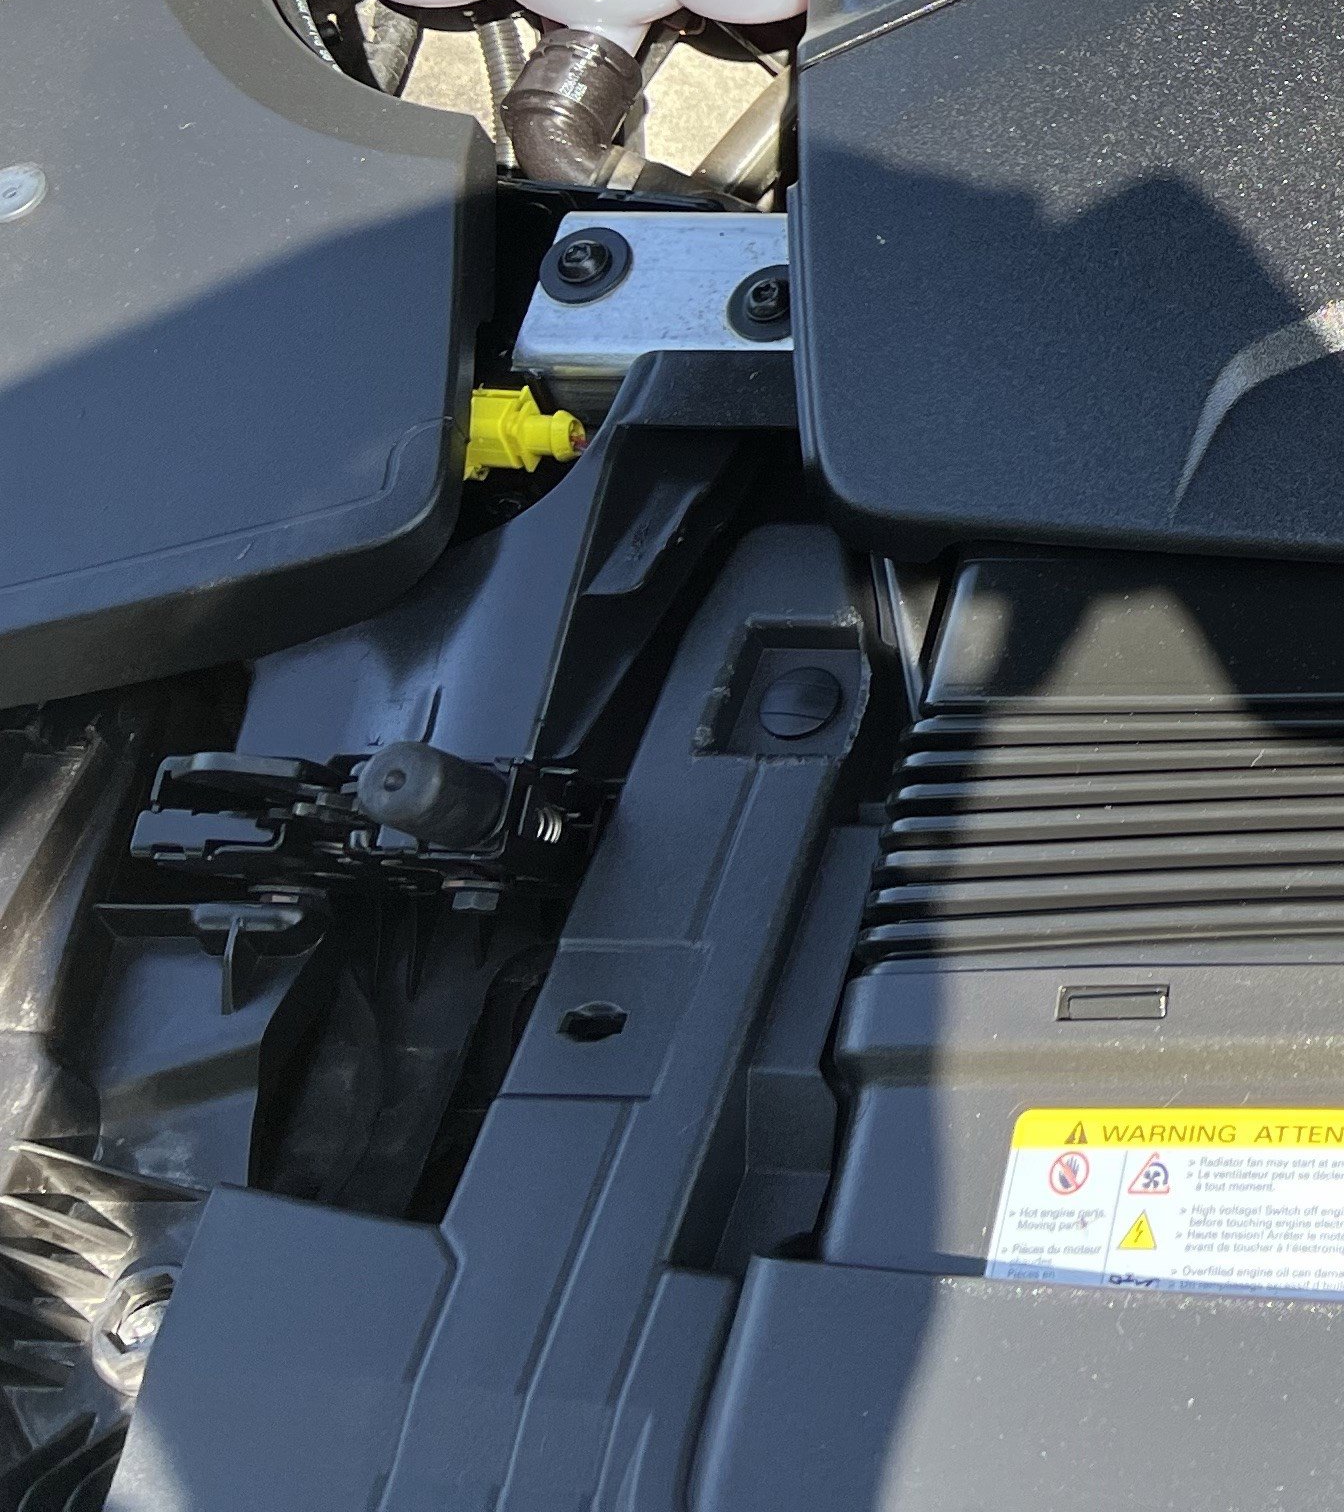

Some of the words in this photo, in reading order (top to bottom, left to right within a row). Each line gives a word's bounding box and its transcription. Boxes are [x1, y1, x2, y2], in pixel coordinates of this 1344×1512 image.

[1102, 1125, 1237, 1143] WARNING
[1199, 1157, 1245, 1168] Radiator
[1246, 1157, 1264, 1168] fan
[1266, 1159, 1288, 1170] may
[1291, 1158, 1315, 1168] start
[1319, 1159, 1328, 1168] at
[1272, 1171, 1294, 1182] peut
[1205, 1182, 1226, 1191] tout
[1019, 1208, 1038, 1217] Hot
[1040, 1208, 1074, 1219] engine
[1191, 1205, 1216, 1218] High
[1219, 1205, 1262, 1217] voltage!
[1265, 1205, 1301, 1216] Switch
[1304, 1205, 1319, 1216] off
[1017, 1219, 1056, 1232] Moving
[1189, 1217, 1222, 1228] before
[1226, 1217, 1273, 1230] touching
[1275, 1219, 1312, 1230] engine
[1047, 1244, 1060, 1254] du
[1063, 1244, 1101, 1254] moteur
[1185, 1243, 1213, 1253] avant
[1216, 1243, 1230, 1252] de
[1233, 1243, 1273, 1254] toucher
[1182, 1267, 1234, 1277] Overfilled
[1237, 1268, 1274, 1278] engine
[1277, 1267, 1290, 1278] oil
[1293, 1270, 1311, 1278] can
